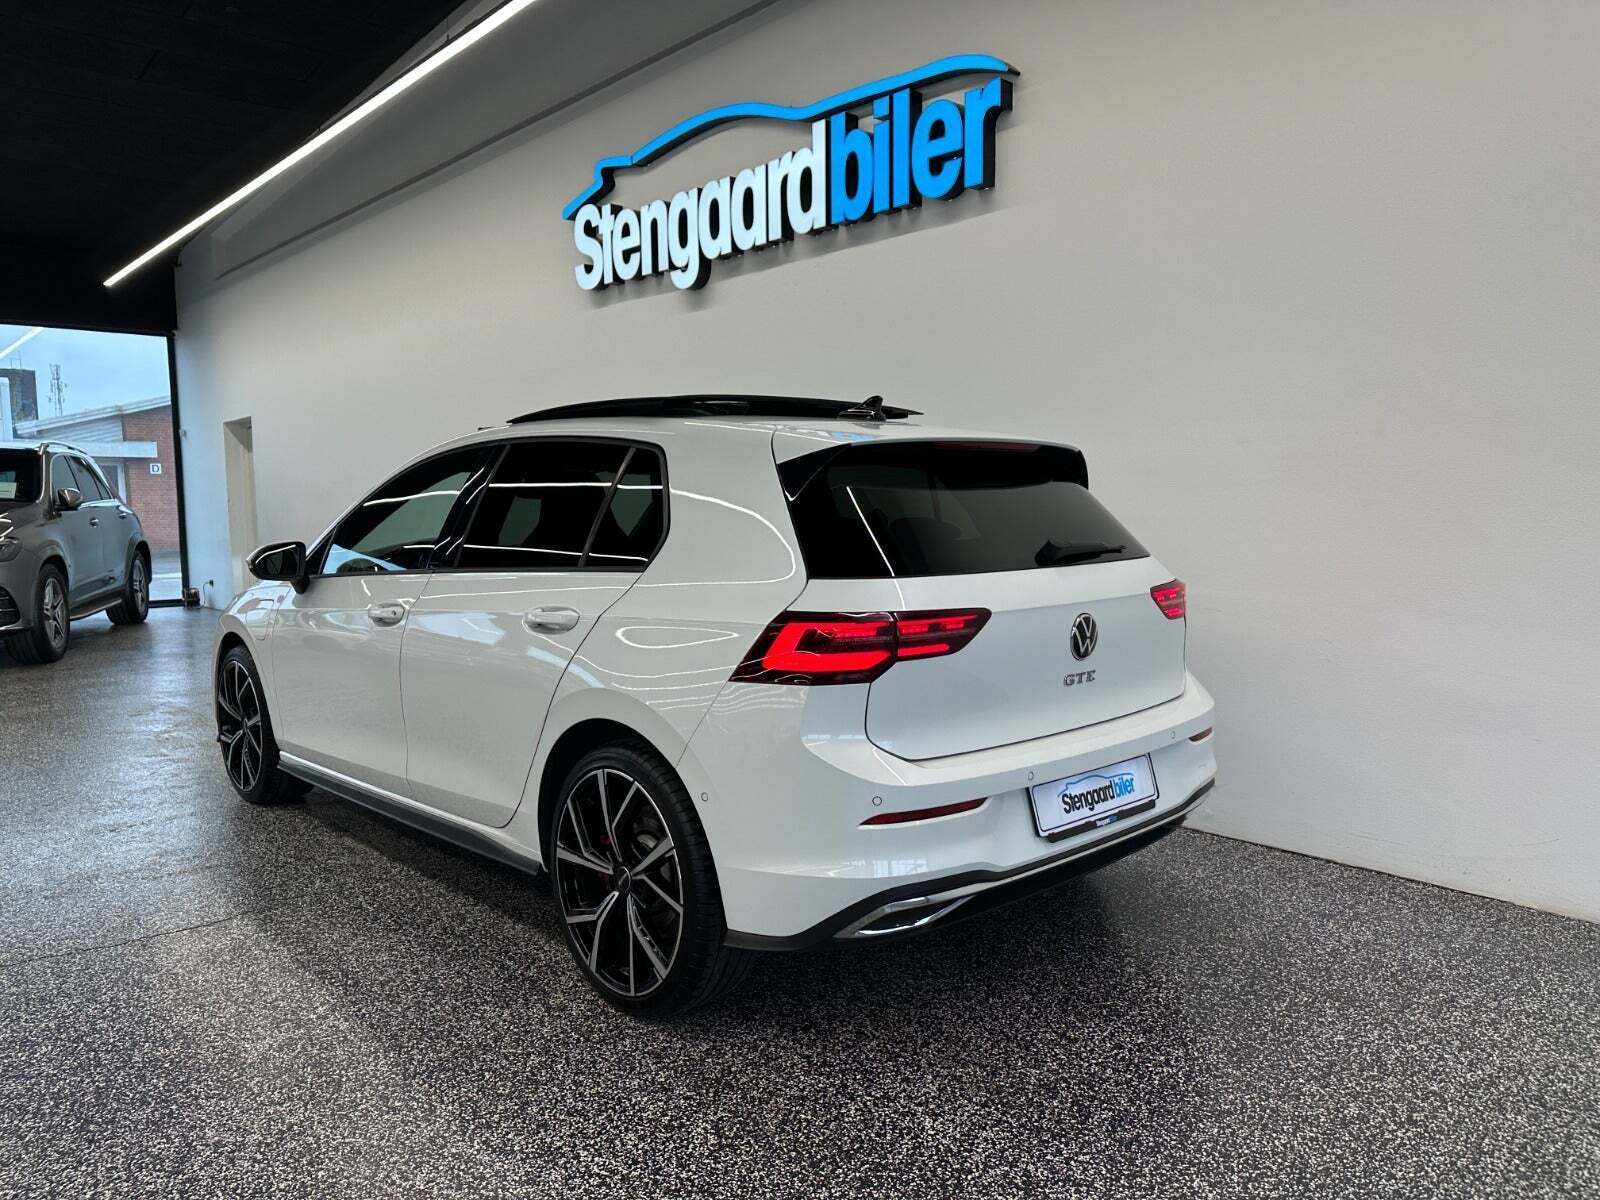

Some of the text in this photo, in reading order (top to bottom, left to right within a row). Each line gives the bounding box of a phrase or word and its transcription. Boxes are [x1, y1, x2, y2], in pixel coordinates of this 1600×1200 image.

[573, 77, 1005, 290] Stengaardbiler
[151, 464, 160, 473] D
[1063, 669, 1096, 687] GTE
[1061, 777, 1135, 814] Stengaardbiler
